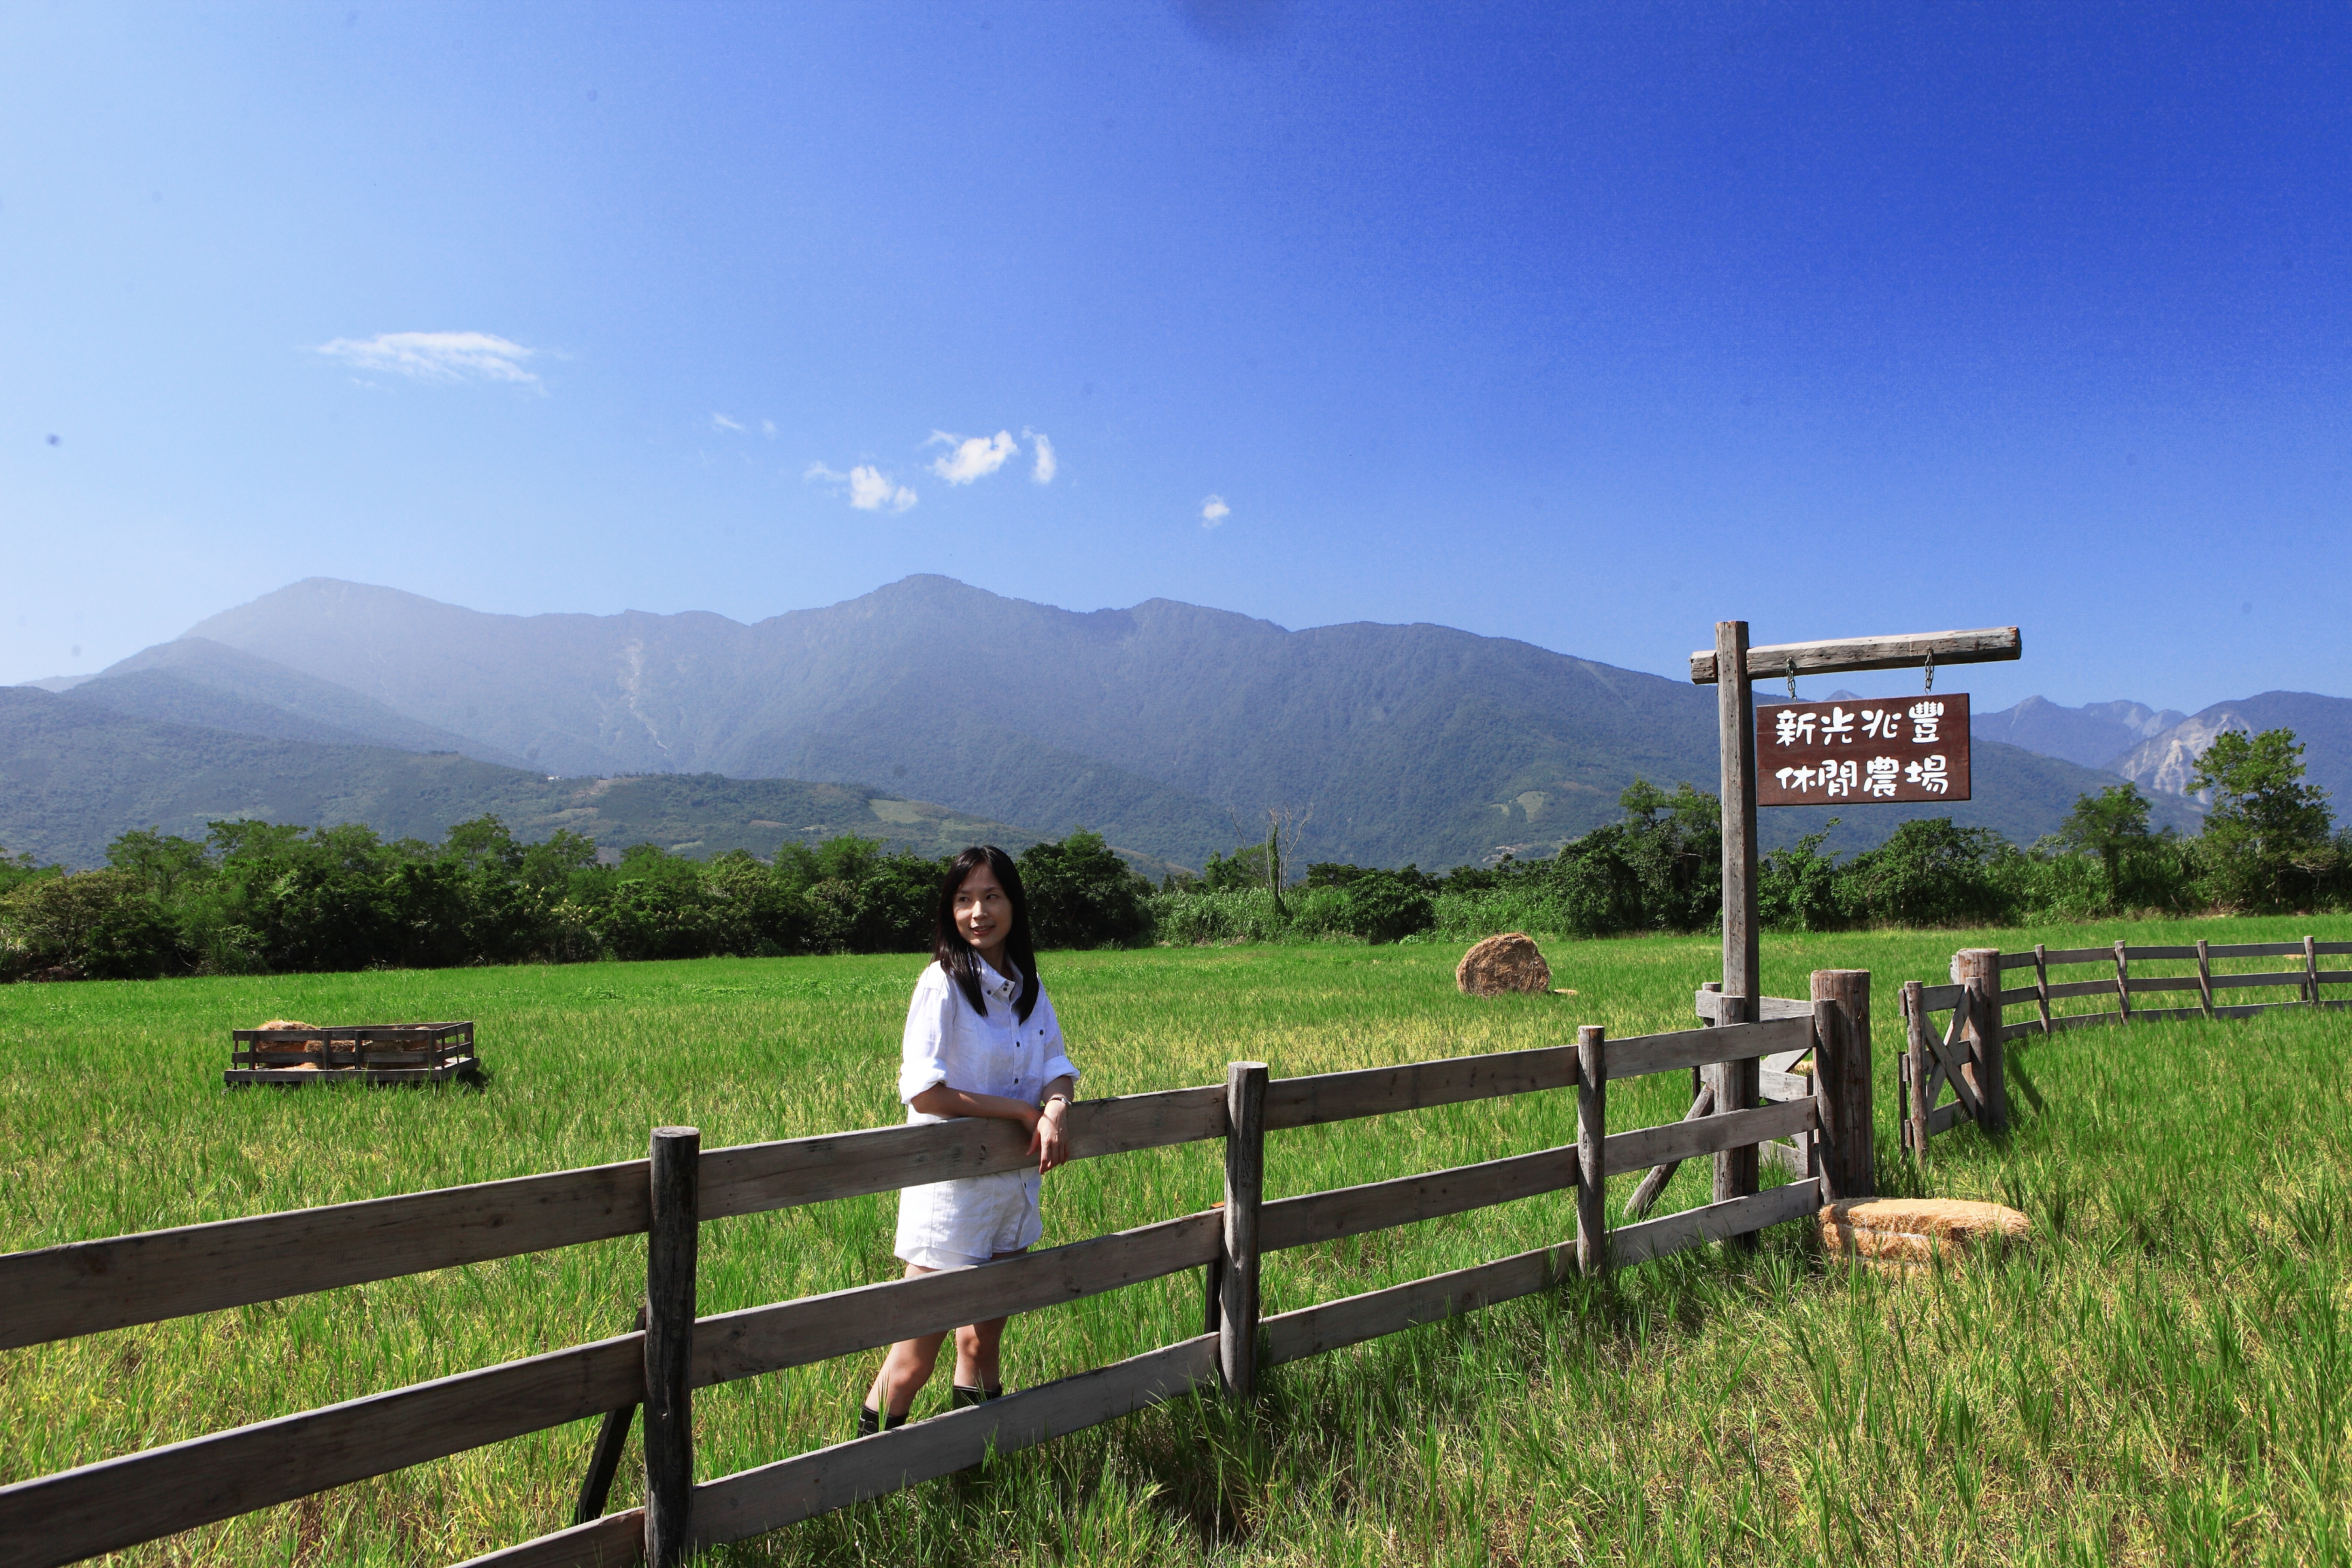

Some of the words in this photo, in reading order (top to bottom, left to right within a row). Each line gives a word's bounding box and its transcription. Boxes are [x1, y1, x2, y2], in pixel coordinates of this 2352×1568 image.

[1775, 701, 1944, 746] 新光兆豐
[1775, 755, 1949, 798] 休閒農場
